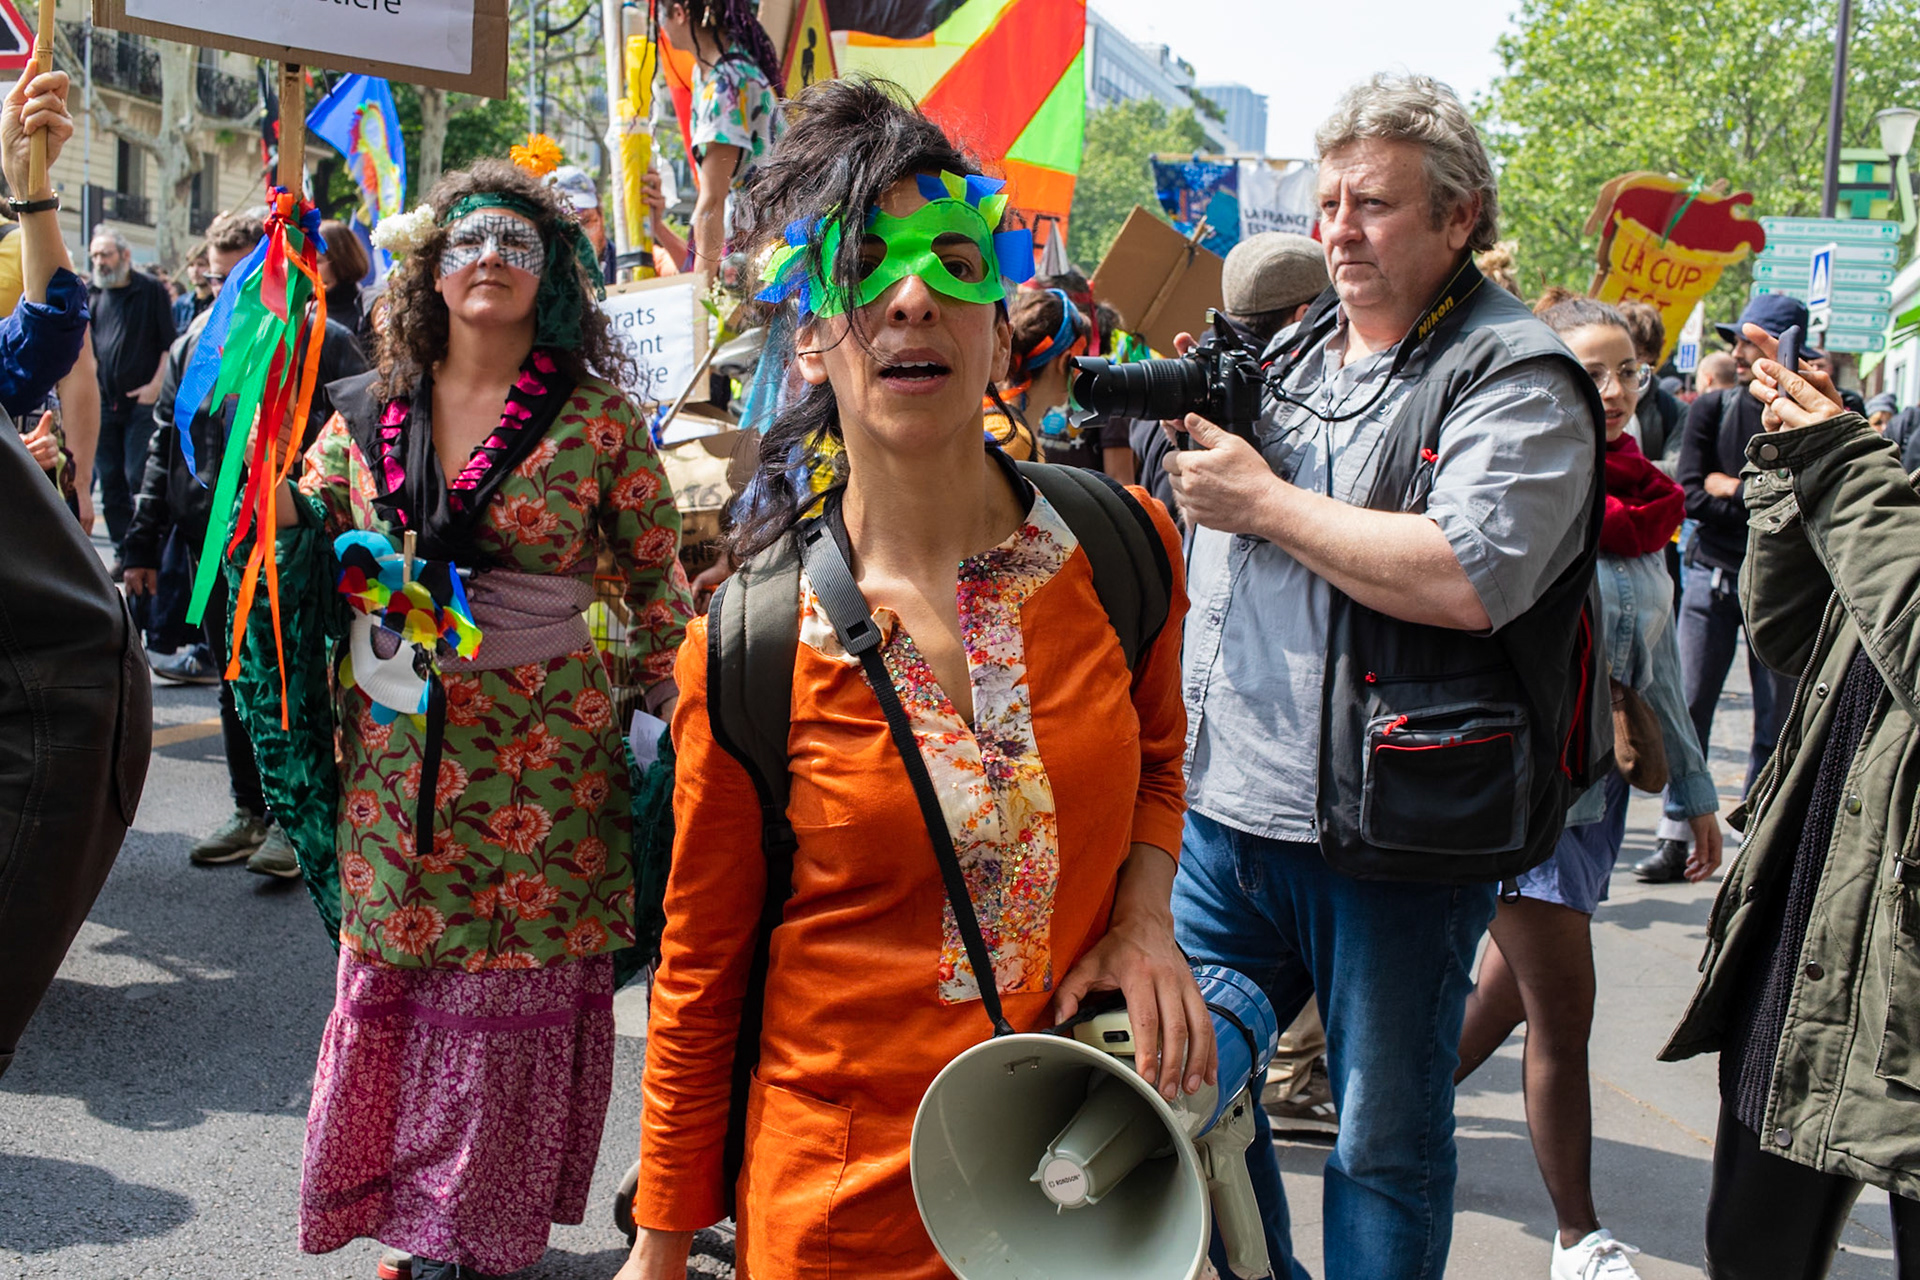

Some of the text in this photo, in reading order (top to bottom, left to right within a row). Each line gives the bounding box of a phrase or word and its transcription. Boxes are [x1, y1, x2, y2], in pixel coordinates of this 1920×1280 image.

[1244, 208, 1309, 227] LA FRANCE
[1621, 243, 1702, 291] LA CUP
[1418, 295, 1454, 339] Nikon
